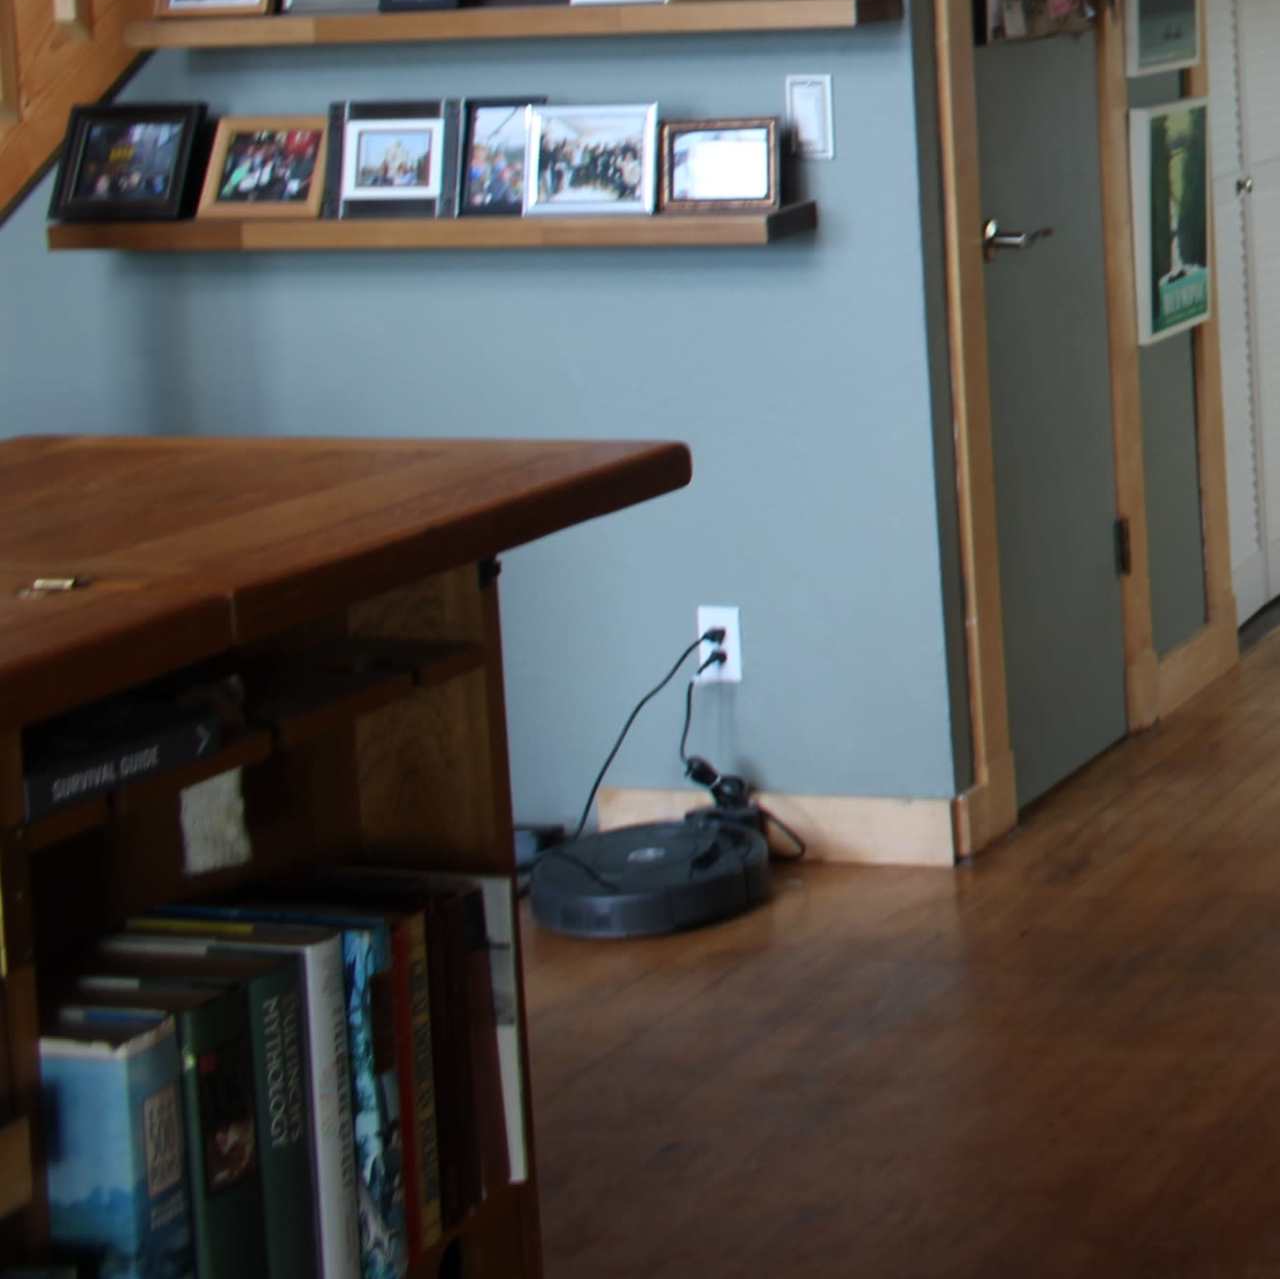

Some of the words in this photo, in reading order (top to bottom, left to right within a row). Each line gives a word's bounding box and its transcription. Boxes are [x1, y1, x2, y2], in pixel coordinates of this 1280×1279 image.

[51, 763, 117, 803] SURVIVAL
[120, 745, 160, 777] GUIDE
[262, 996, 288, 1149] MYTHOLOGY
